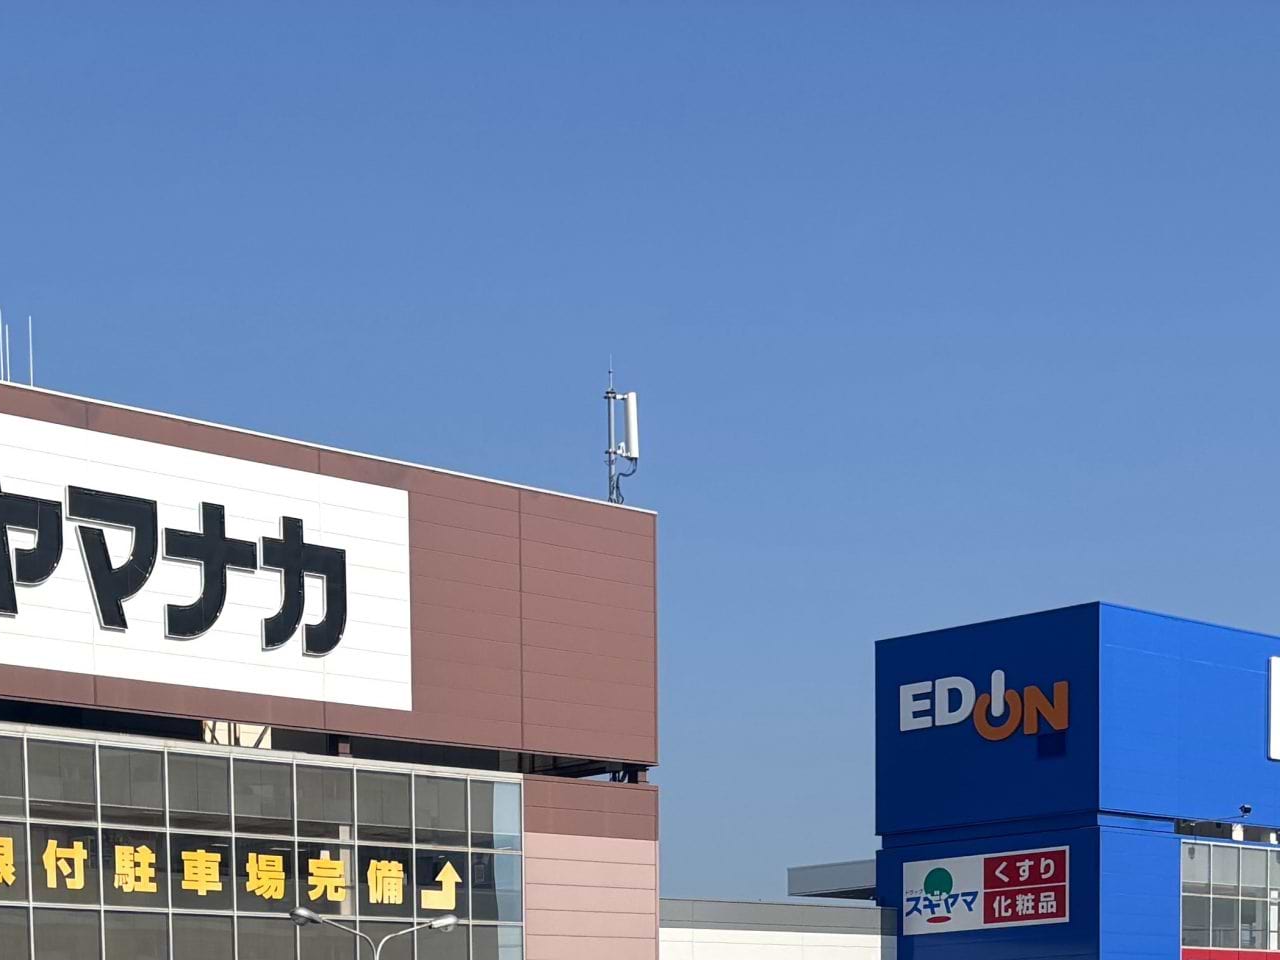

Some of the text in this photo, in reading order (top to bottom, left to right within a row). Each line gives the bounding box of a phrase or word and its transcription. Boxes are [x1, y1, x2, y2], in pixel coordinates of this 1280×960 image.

[899, 669, 1069, 741] EDION
[994, 857, 1055, 882] くすり
[905, 890, 979, 917] スギヤマ
[993, 891, 1057, 918] 化粧品
